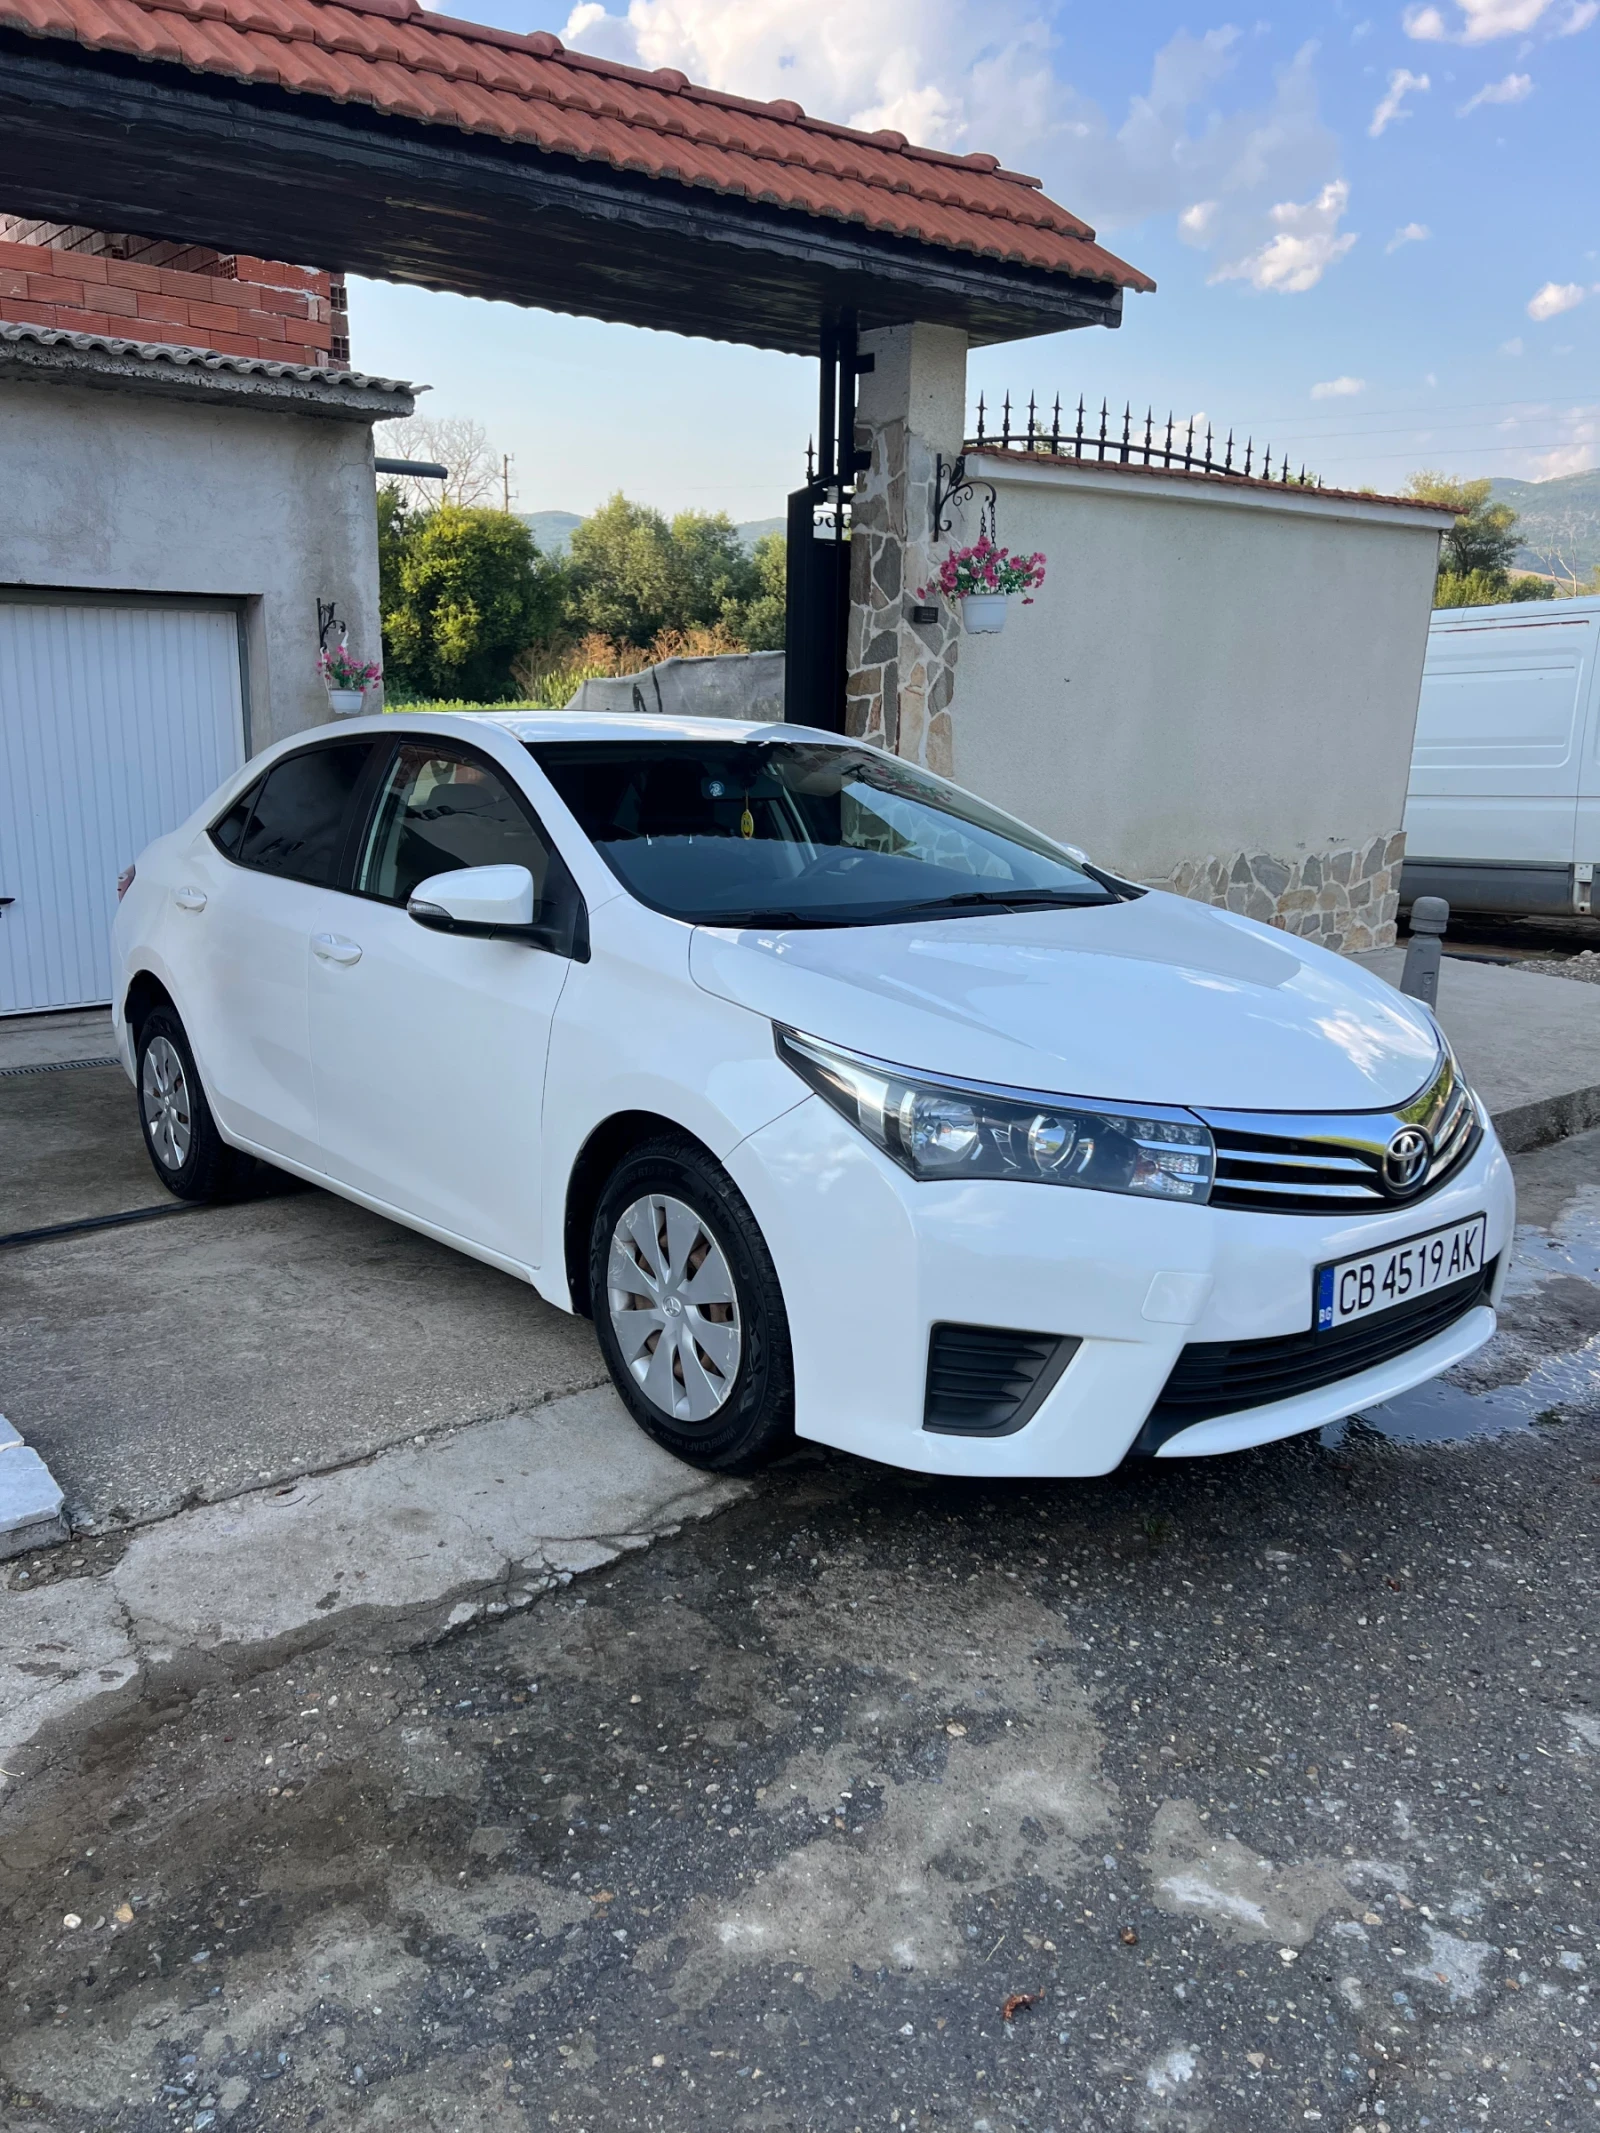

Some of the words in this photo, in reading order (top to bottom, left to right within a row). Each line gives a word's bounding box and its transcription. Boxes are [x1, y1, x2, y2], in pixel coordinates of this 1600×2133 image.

[1339, 1263, 1375, 1316] CB
[1382, 1239, 1444, 1299] 4519
[1448, 1225, 1479, 1277] AK
[1318, 1306, 1333, 1324] BG
